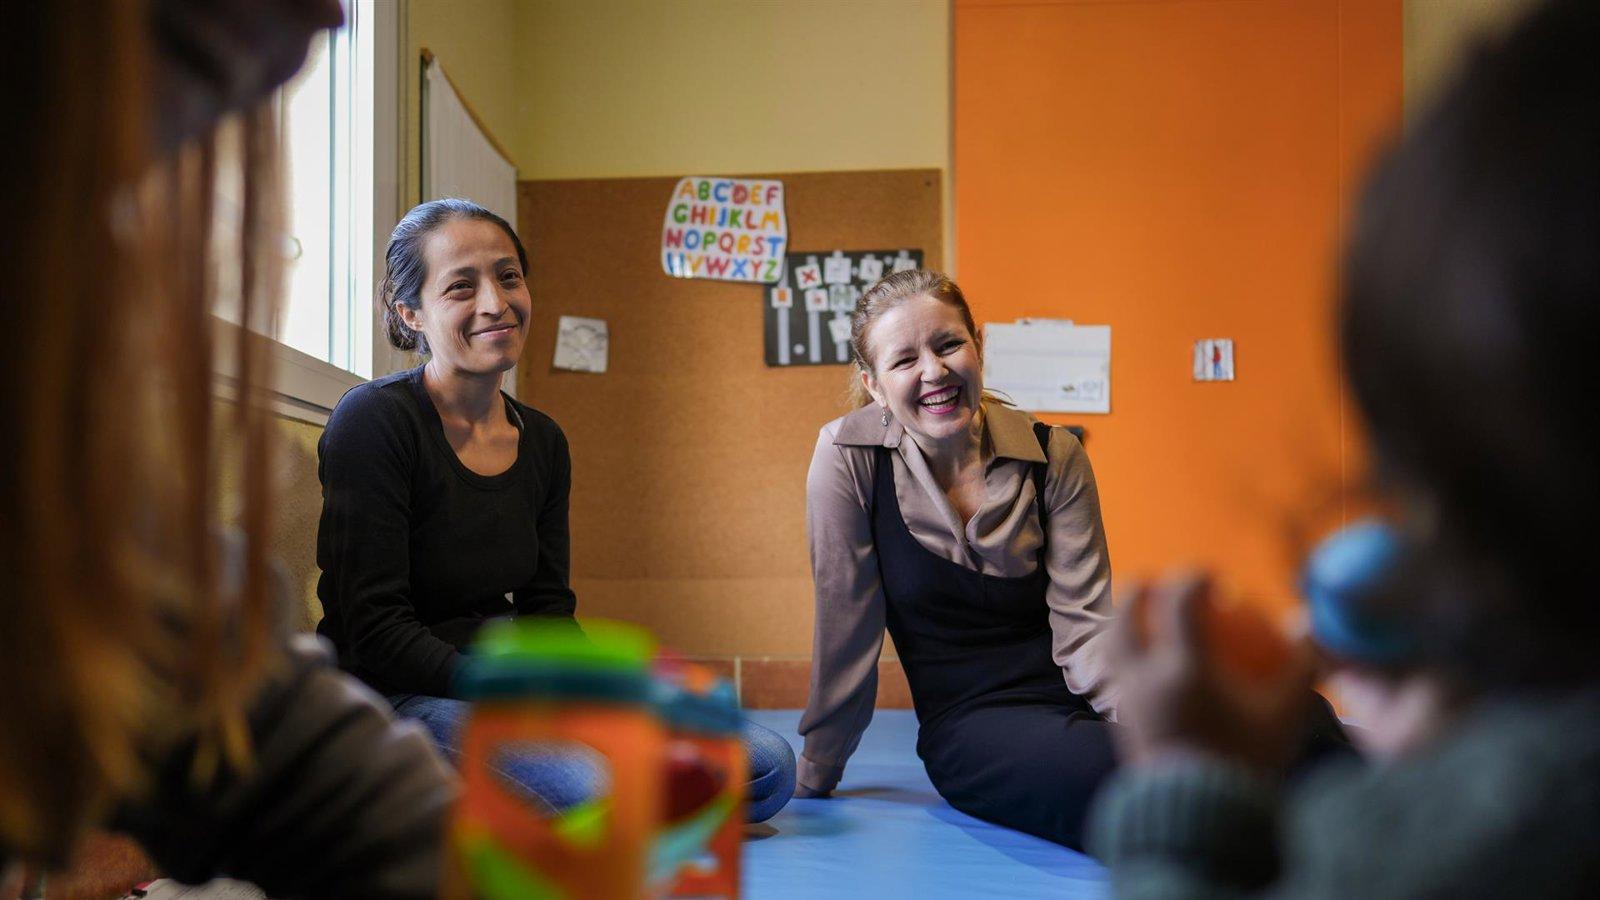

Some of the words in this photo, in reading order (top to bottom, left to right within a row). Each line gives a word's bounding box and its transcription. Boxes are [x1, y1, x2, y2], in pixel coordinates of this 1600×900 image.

[679, 180, 779, 205] ABCDEF
[673, 203, 781, 231] GHIJKLM
[665, 228, 784, 256] NOPQRST
